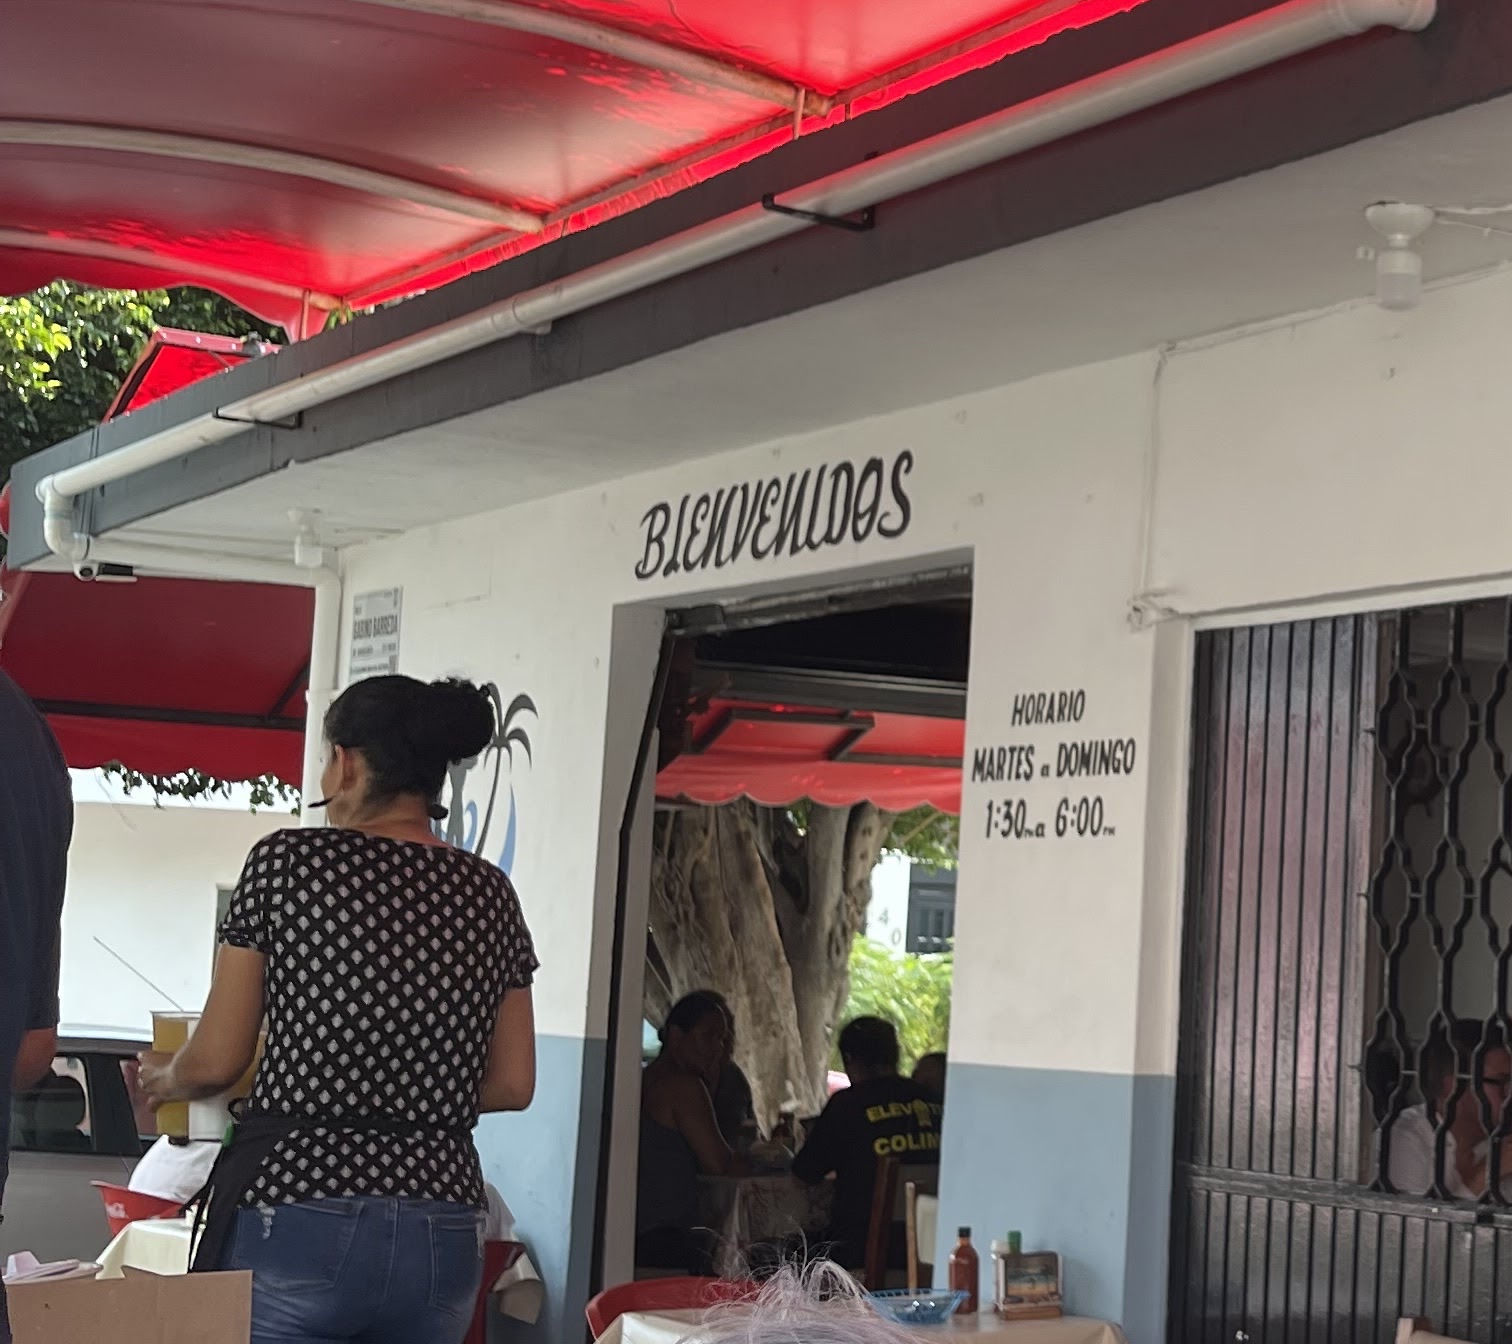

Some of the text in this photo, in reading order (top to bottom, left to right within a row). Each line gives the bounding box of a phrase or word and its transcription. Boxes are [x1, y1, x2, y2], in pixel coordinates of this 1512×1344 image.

[634, 450, 914, 580] BIENVENIDOS
[1010, 688, 1086, 727] HORARIO
[971, 744, 1035, 783] MARTES
[1055, 737, 1136, 778] DOMINGO
